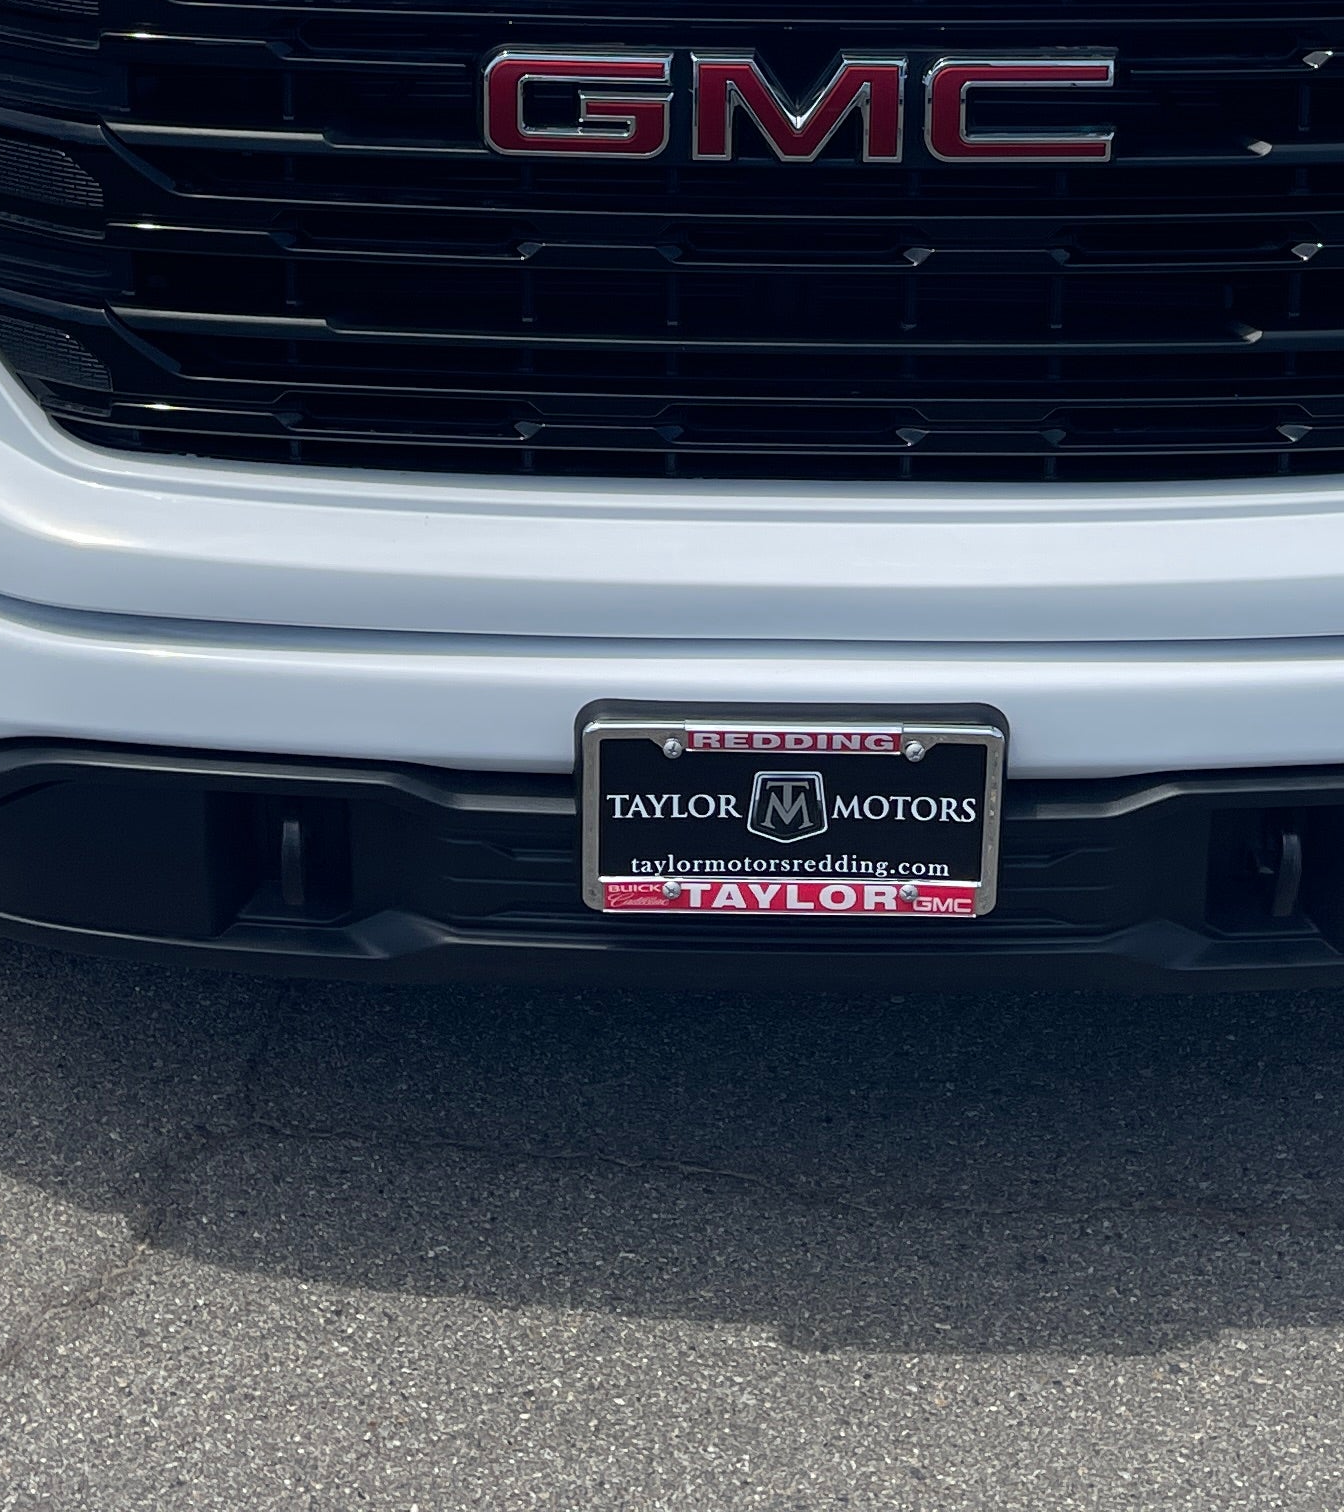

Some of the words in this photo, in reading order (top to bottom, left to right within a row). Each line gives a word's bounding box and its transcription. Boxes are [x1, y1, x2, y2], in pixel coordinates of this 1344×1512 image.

[482, 46, 1118, 163] GMC
[692, 732, 897, 753] REDDING
[606, 793, 743, 820] TAYLOR
[831, 794, 977, 823] MOTORS
[630, 853, 951, 878] taylormotorsredding.com
[607, 883, 662, 893] BUICK
[680, 882, 898, 911] TAYLOR
[912, 896, 973, 913] GMC
